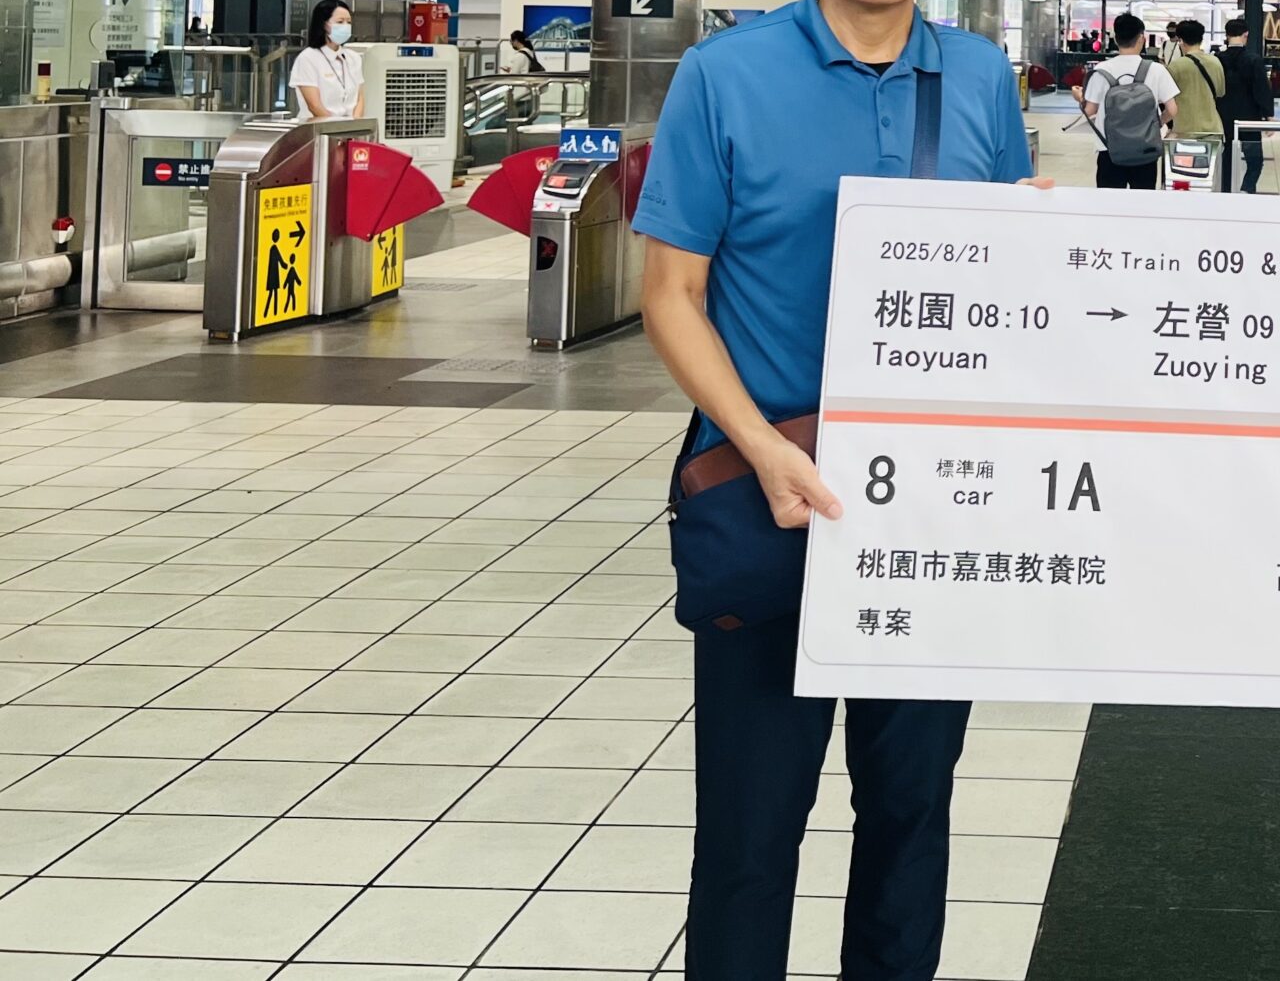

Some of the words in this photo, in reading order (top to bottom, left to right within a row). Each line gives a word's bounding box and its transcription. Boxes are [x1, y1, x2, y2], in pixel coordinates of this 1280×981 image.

[881, 242, 988, 262] 2025/8/21
[1067, 247, 1112, 270] 車次
[1122, 252, 1179, 271] Train
[1198, 250, 1243, 273] 609
[1262, 252, 1276, 275] &
[875, 290, 954, 330] 桃園
[968, 304, 1049, 329] 08:10
[1153, 301, 1229, 341] 左營
[873, 342, 987, 372] Taoyuan
[1154, 353, 1267, 384] Zuoying
[866, 456, 895, 505] 8
[936, 459, 993, 478] 標準廂
[954, 491, 993, 505] car
[1041, 461, 1100, 511] 1A
[856, 549, 1105, 584] 桃園市嘉惠教養院
[856, 608, 910, 636] 專案
